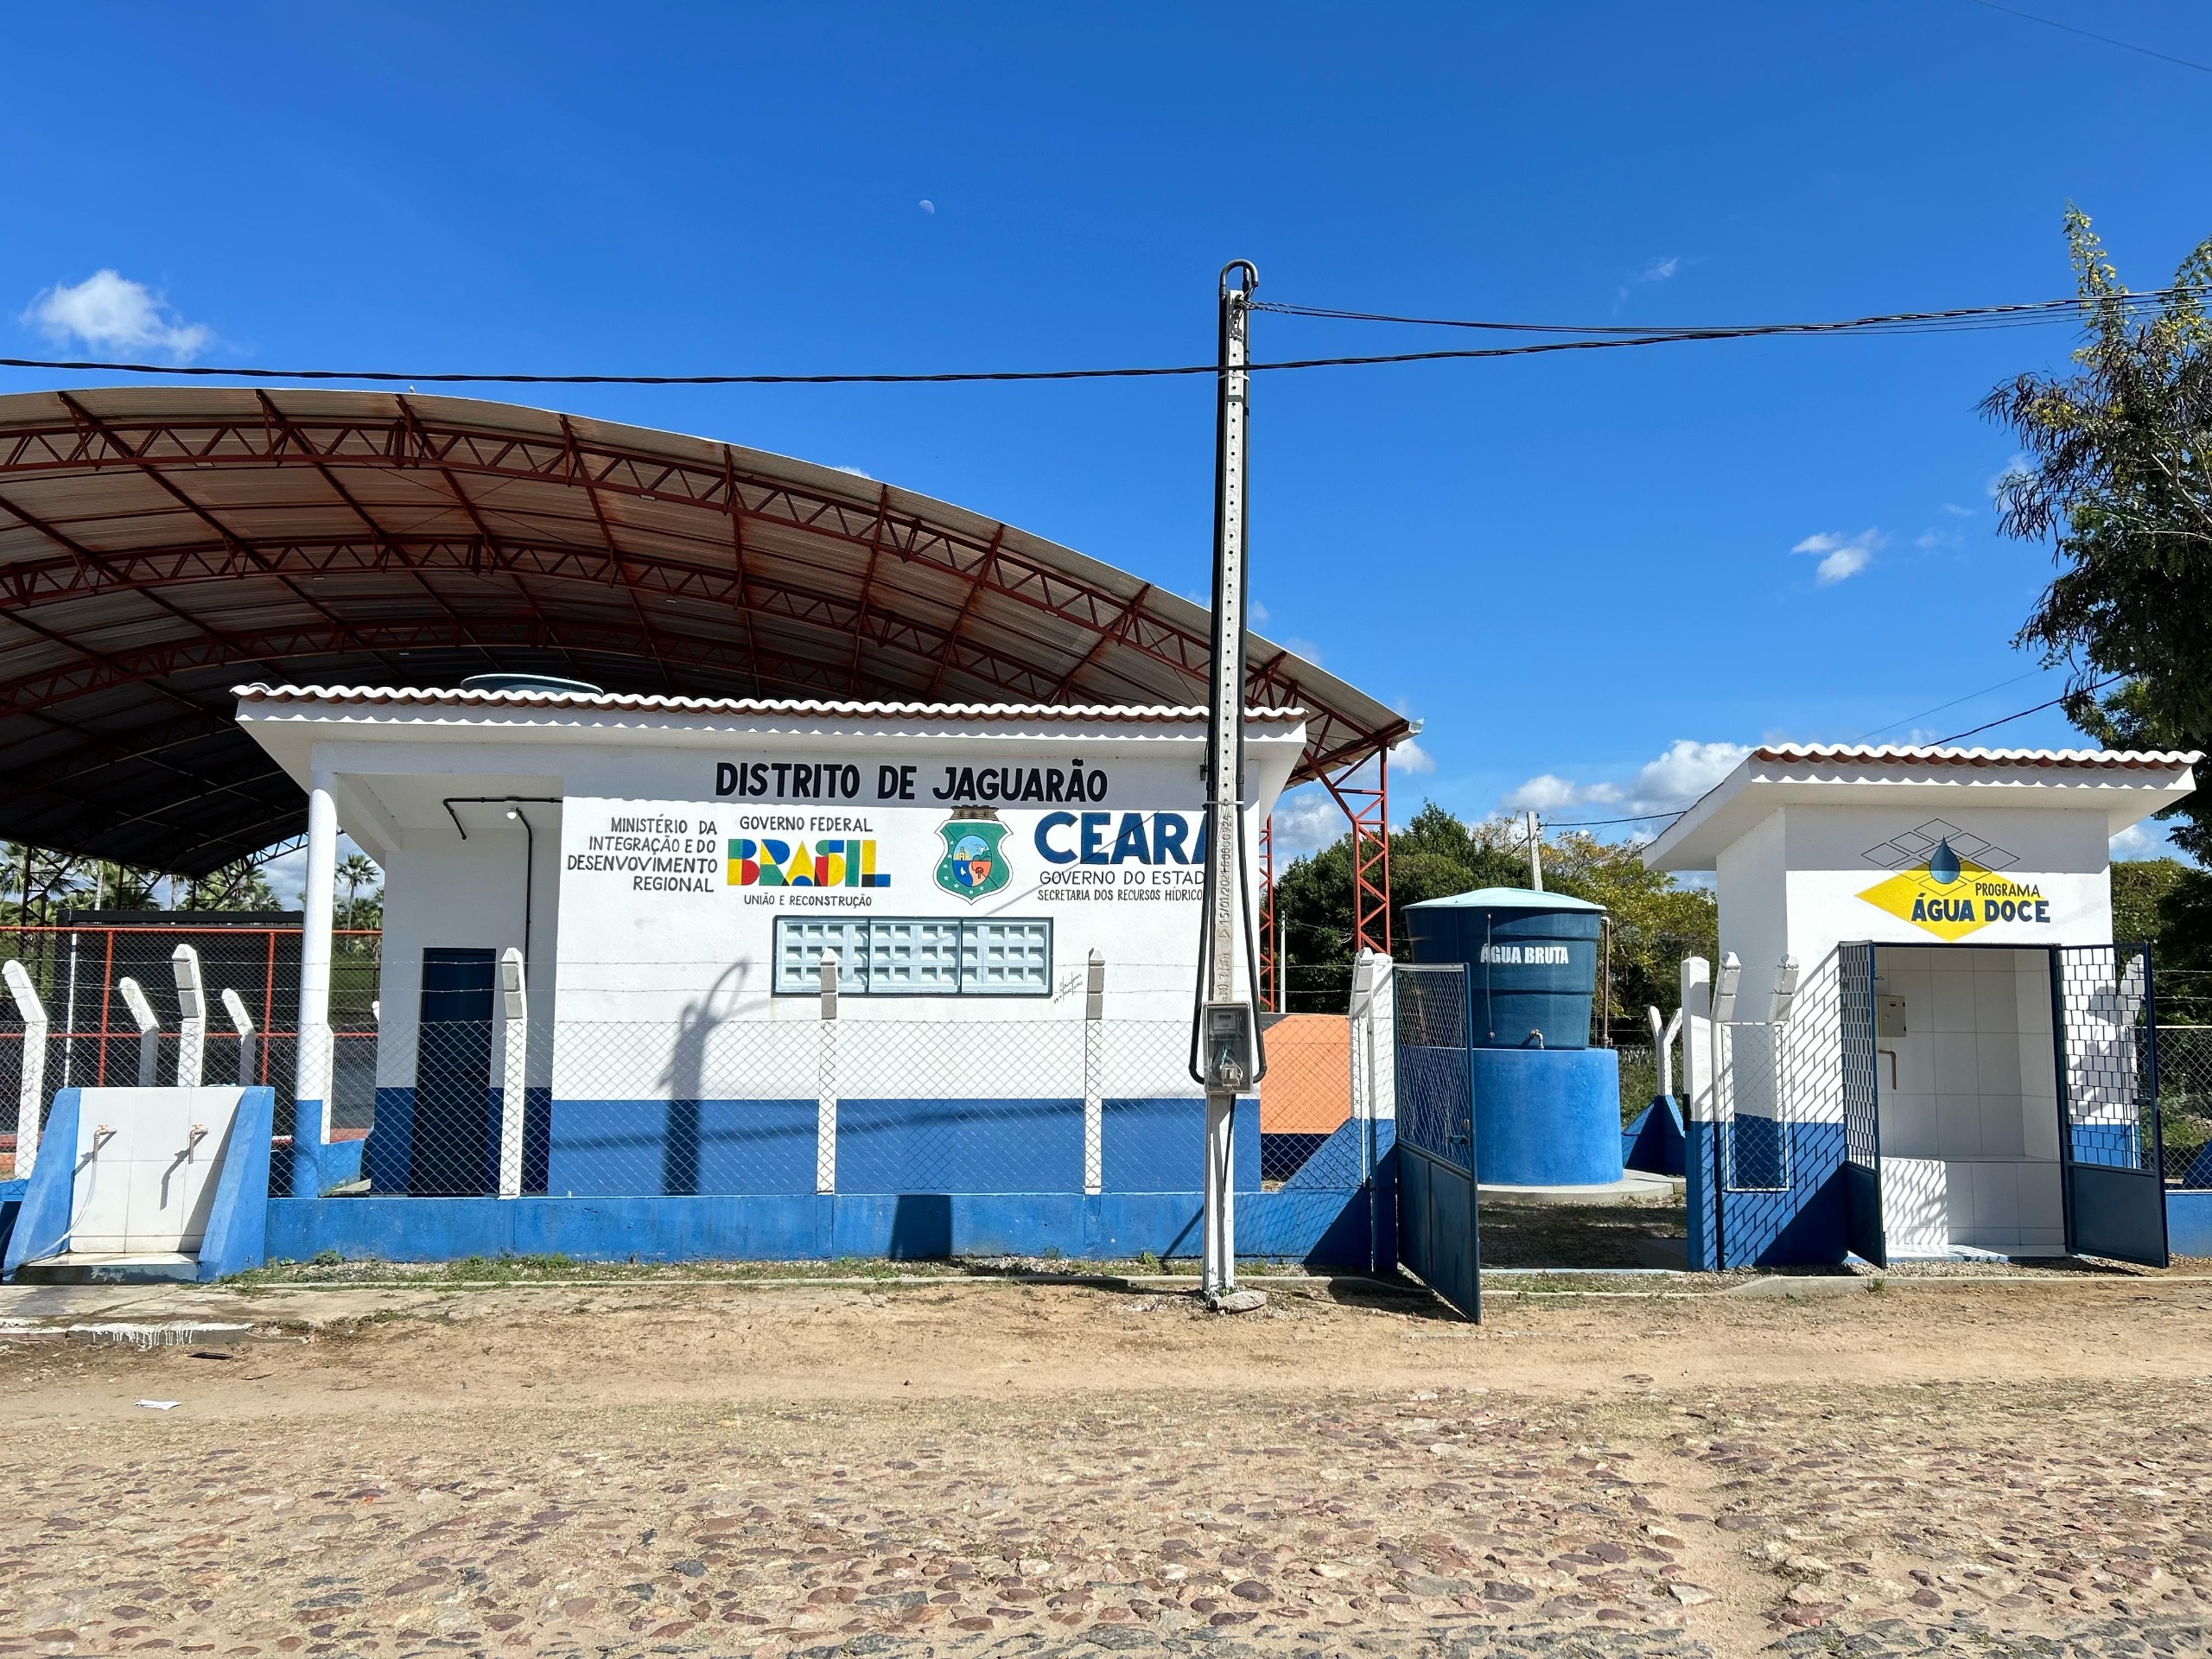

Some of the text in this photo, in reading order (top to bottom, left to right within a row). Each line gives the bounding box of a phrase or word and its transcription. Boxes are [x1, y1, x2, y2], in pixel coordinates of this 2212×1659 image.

[716, 759, 1107, 802] DISTRITO DE JAGUARÃO
[612, 814, 717, 835] MINISTÉRIO DA
[741, 817, 873, 832] GOVERNO FEDERAL
[589, 836, 715, 856] INTEGRAÇÃO E DO
[1034, 811, 1205, 865] CEAR
[568, 855, 717, 874] DESENVOVIMENTO
[727, 839, 891, 887] BRASIL
[633, 876, 714, 892] REGIONAL
[1040, 871, 1204, 885] GOVERNO DO ESTAD
[1038, 887, 1202, 901] SECRETARIA DOS RECURSOS HÍDRICO
[1976, 883, 2040, 897] PROGRAMA
[745, 893, 872, 908] UNIÃO E RECONSTRUÇÃO
[1911, 893, 2050, 923] ÁGUA DOCE
[1480, 943, 1570, 964] ÁGUA BRUTA
